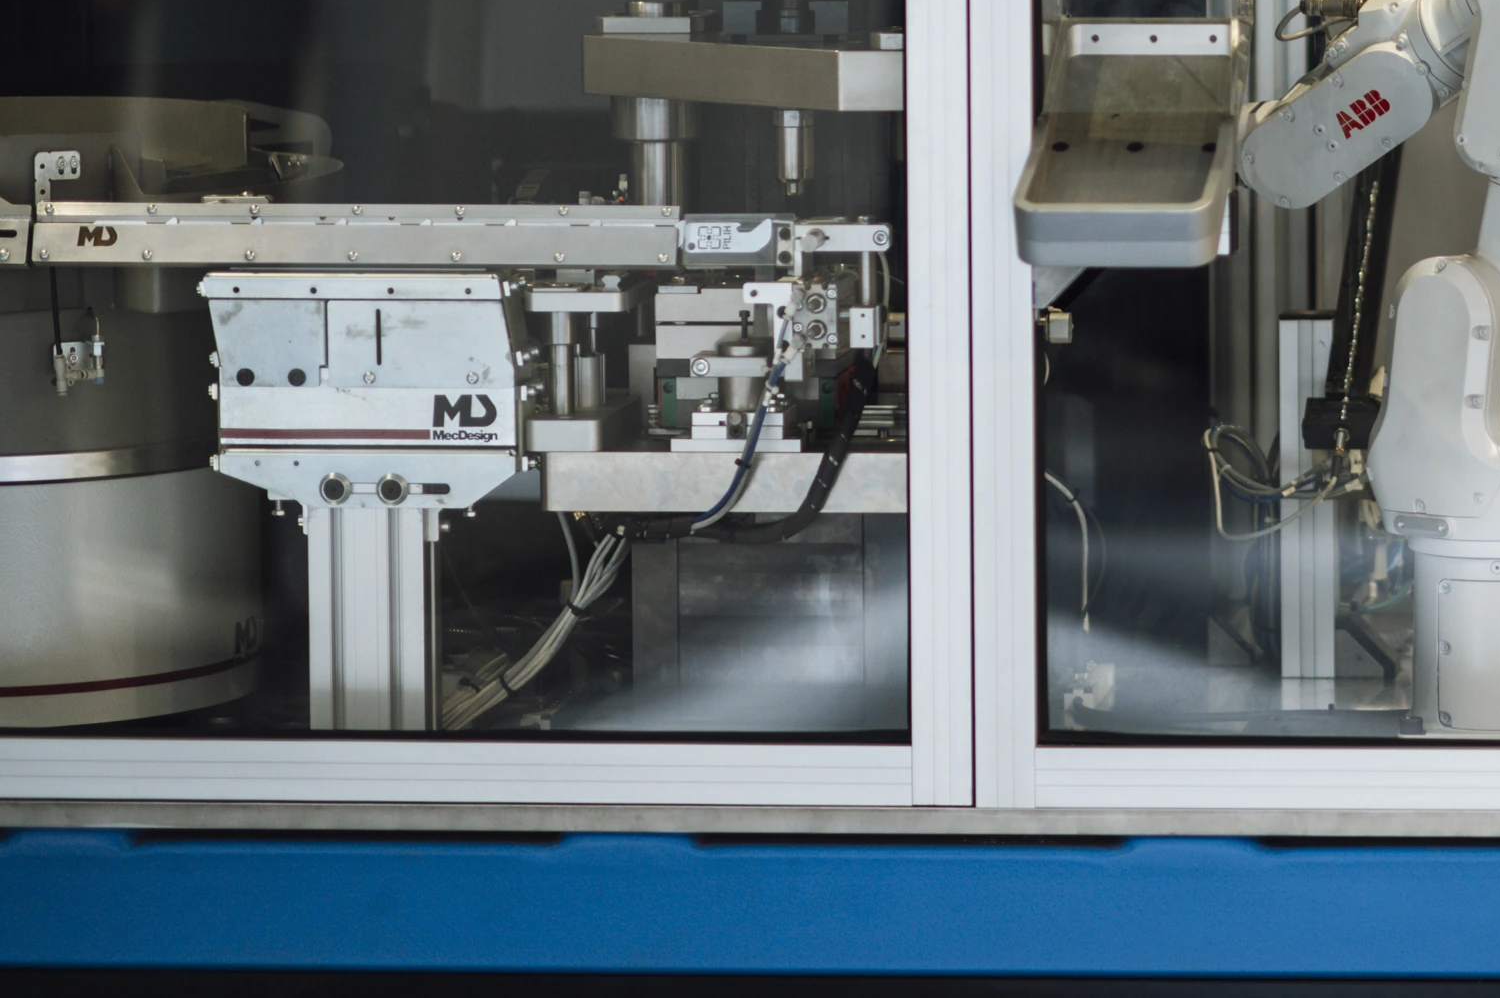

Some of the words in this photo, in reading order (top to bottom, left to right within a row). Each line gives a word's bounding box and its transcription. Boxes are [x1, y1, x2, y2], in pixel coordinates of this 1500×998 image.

[1336, 89, 1391, 140] ABB
[722, 225, 732, 250] PILIH
[432, 430, 498, 443] MecDesign
